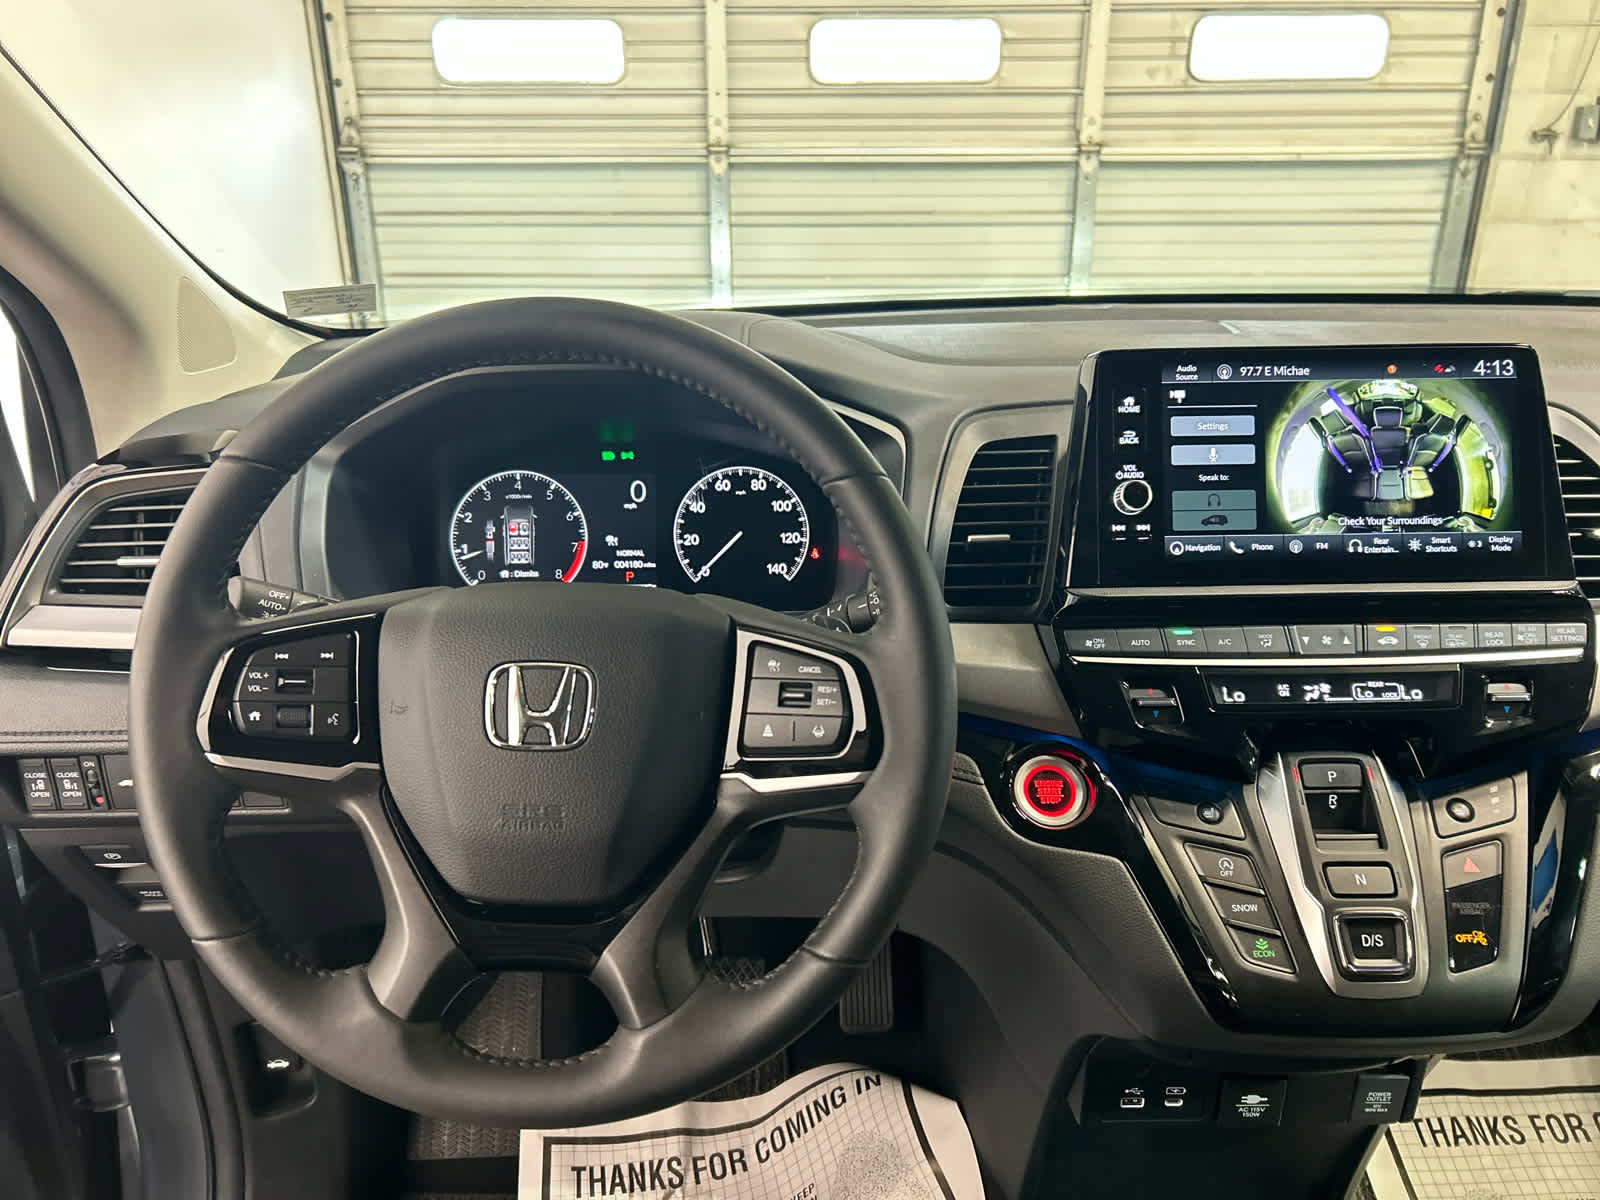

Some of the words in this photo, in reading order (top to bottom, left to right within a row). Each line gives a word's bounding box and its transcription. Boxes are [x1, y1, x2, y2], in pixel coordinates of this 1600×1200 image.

[1176, 364, 1198, 373] Audio
[1240, 366, 1262, 377] 97.7
[1265, 366, 1272, 377] E
[1274, 366, 1310, 377] Michae
[1472, 359, 1514, 376] 4:13
[1175, 373, 1199, 381] Source
[1118, 405, 1141, 413] HOME
[1197, 421, 1229, 432] Settings
[1118, 436, 1140, 445] BACK
[1123, 471, 1145, 480] AUDIO
[1198, 474, 1215, 482] Speak
[1216, 473, 1230, 482] to:
[514, 480, 523, 491] 4
[715, 478, 732, 492] 60
[750, 478, 767, 492] 80
[483, 490, 492, 501] 3
[546, 490, 554, 501] 5
[630, 479, 647, 503] 0
[623, 502, 638, 510] mph
[689, 500, 706, 514] 40
[771, 499, 793, 513] 100
[463, 512, 473, 523] 2
[566, 512, 574, 522] 6
[1338, 516, 1362, 526] Check
[1363, 516, 1386, 526] Your
[1386, 515, 1444, 527] Surroundings
[683, 532, 700, 546] 20
[779, 531, 801, 545] 120
[1373, 537, 1390, 546] Rear
[1431, 536, 1452, 545] Smart
[1488, 535, 1514, 546] Display
[460, 544, 469, 554] 1
[570, 542, 579, 553] 7
[1185, 543, 1221, 552] Navigation
[1251, 542, 1274, 551] Phone
[1315, 542, 1329, 550] FM
[1425, 544, 1458, 553] Shortcuts
[1490, 544, 1513, 552] Mode
[616, 549, 645, 557] NORMAL
[614, 560, 644, 569] 004180
[766, 561, 789, 576] 140
[477, 569, 486, 581] 0
[555, 569, 563, 580] 8
[625, 571, 635, 582] P
[268, 590, 287, 600] OFF
[258, 599, 283, 610] AUTO
[1131, 638, 1151, 647] AUTO
[1176, 638, 1197, 647] SYNC
[1217, 638, 1232, 646] A/C
[798, 665, 822, 674] CANCEL
[1222, 686, 1246, 702] Lo
[1356, 687, 1374, 699] Lo
[1400, 684, 1423, 700] Lo
[1327, 771, 1337, 783] P
[1328, 794, 1338, 805] R
[1354, 873, 1368, 886] N
[1231, 903, 1258, 912] SNOW
[1361, 934, 1384, 948] D/S
[1455, 934, 1474, 943] OFF
[1252, 950, 1276, 958] ECON
[1413, 1115, 1527, 1148] THANKS
[1528, 1113, 1593, 1144] FOR
[571, 1156, 685, 1199] THANKS
[692, 1149, 749, 1186] FOR
[754, 1086, 848, 1165] COMING
[855, 1074, 883, 1097] IN
